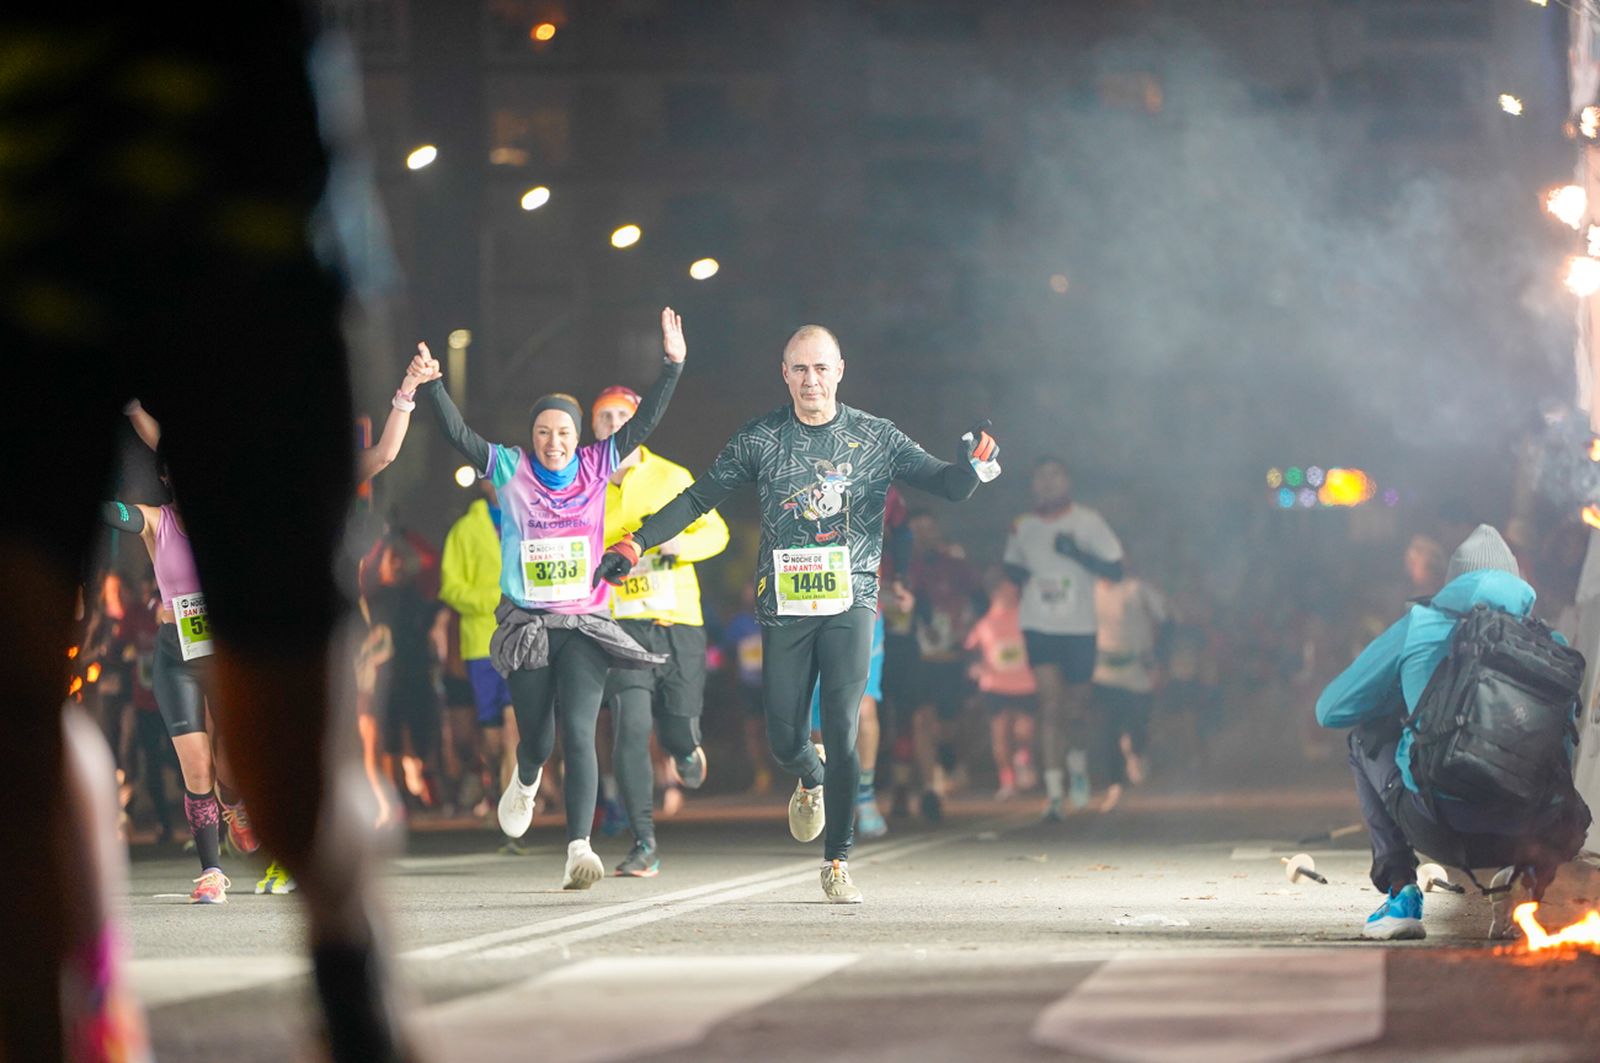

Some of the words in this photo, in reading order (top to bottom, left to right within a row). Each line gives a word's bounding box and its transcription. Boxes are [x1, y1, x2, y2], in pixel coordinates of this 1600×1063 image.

[790, 555, 813, 563] NOCHE
[535, 560, 578, 580] 3233
[783, 564, 798, 573] SAN
[791, 571, 836, 593] 1446
[183, 608, 198, 617] SAN
